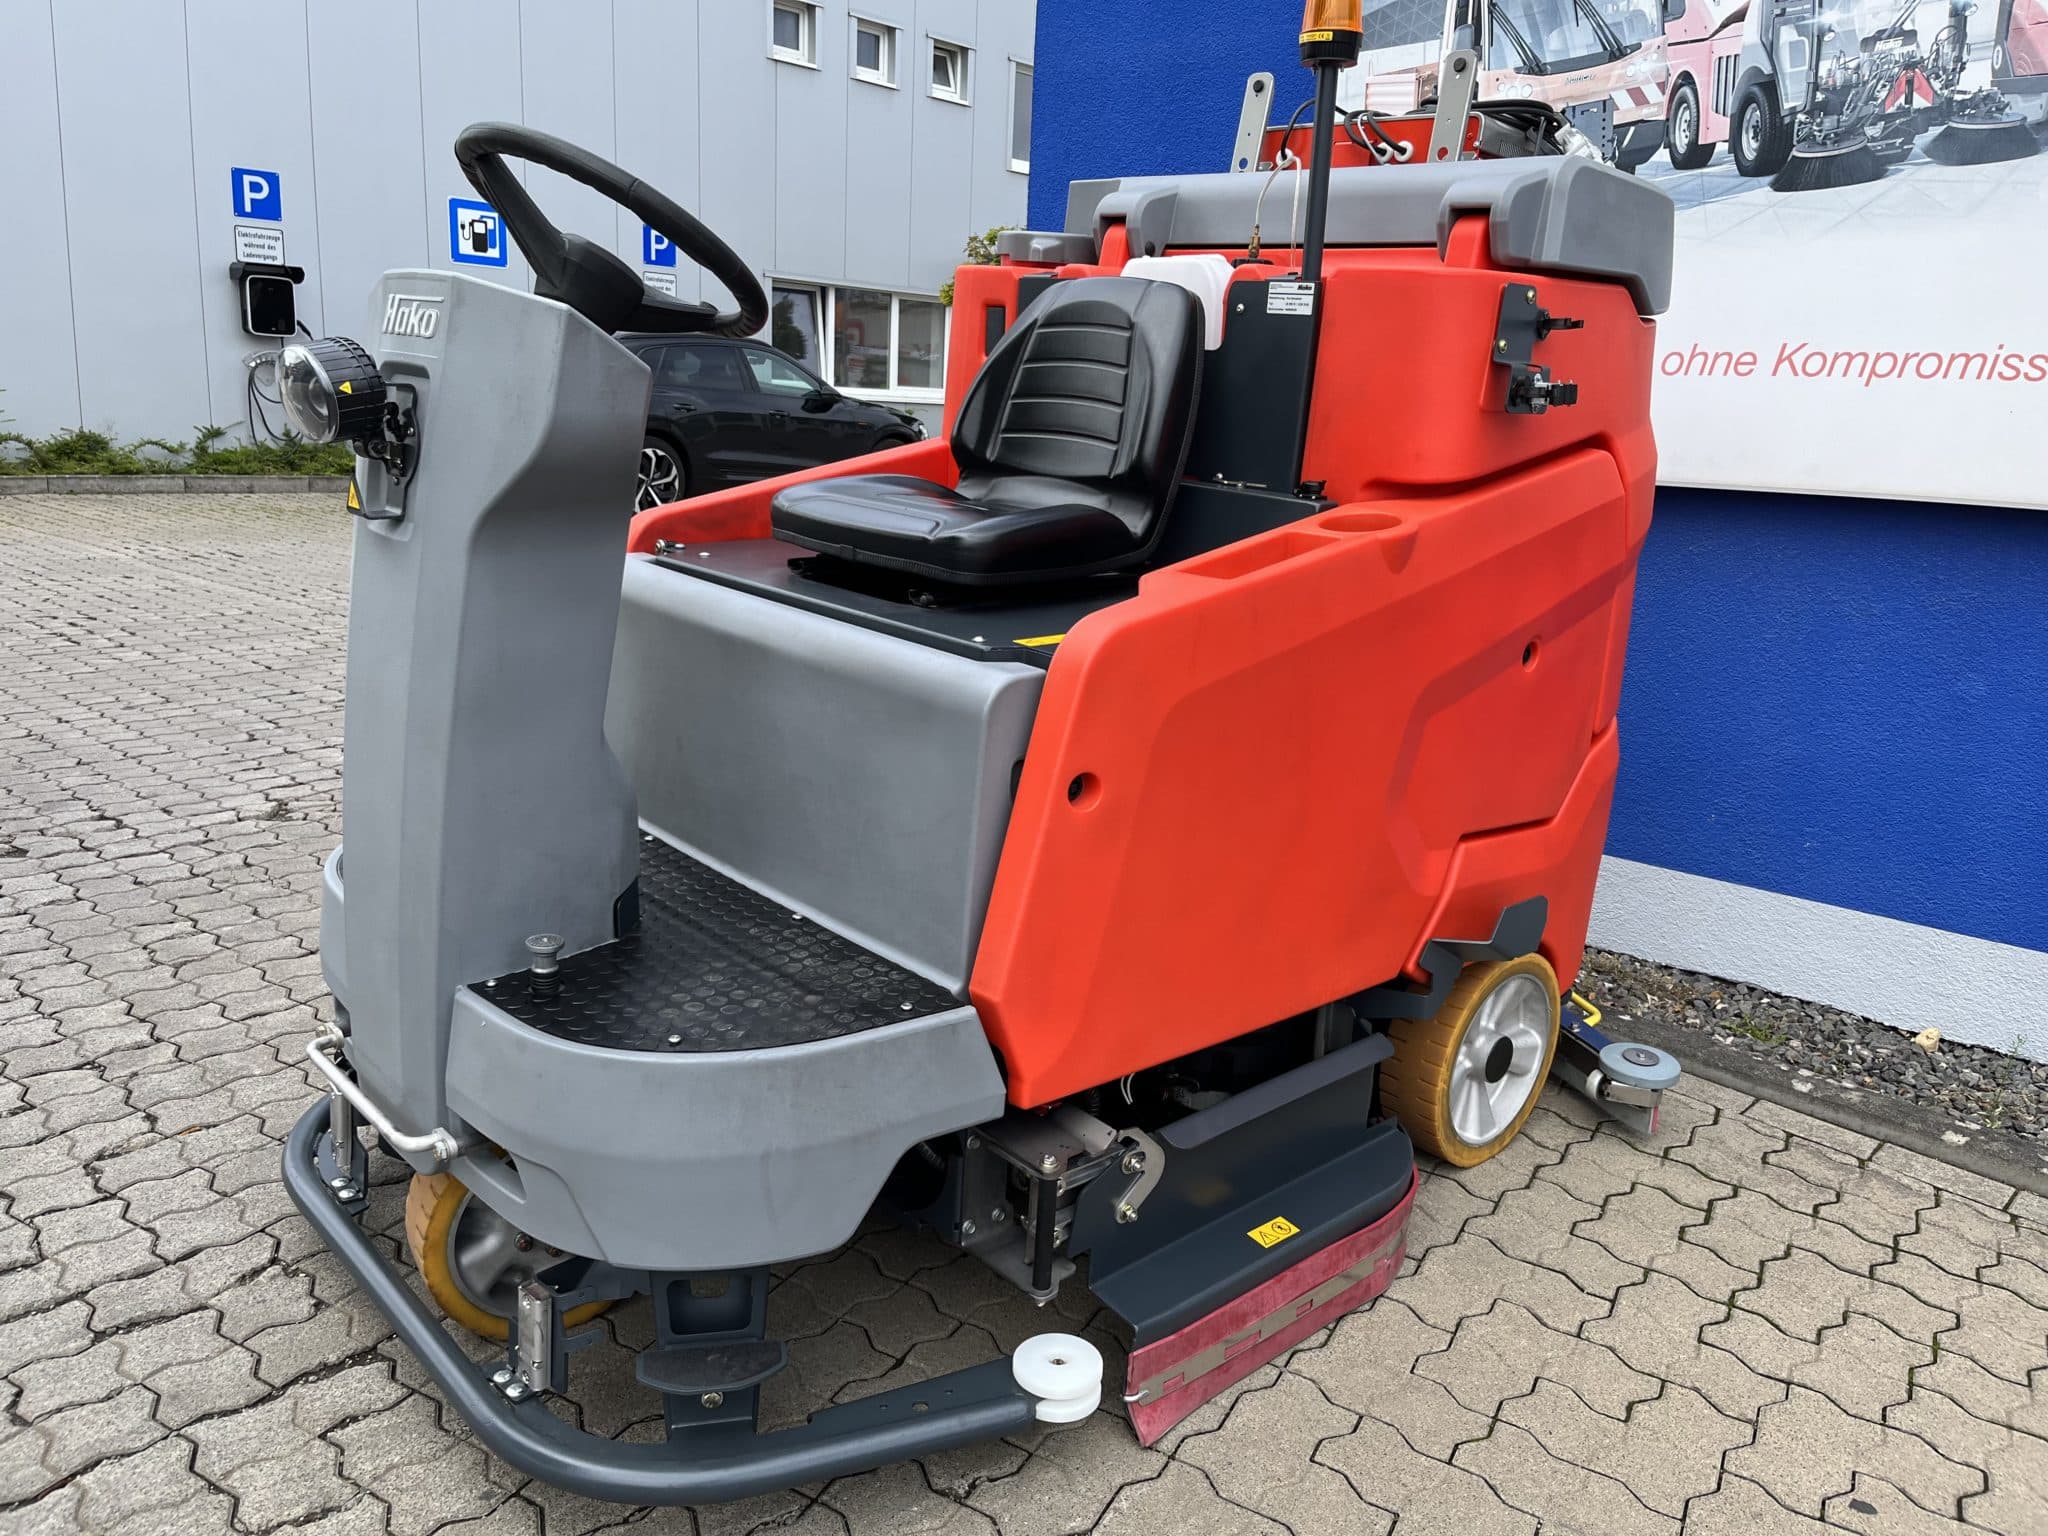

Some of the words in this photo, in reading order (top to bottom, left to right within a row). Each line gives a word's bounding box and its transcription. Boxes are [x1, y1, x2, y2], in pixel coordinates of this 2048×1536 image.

[243, 174, 269, 212] P
[267, 243, 276, 251] des
[650, 228, 669, 261] P
[382, 294, 444, 338] Hako
[1661, 343, 1757, 376] ohne
[1771, 342, 2048, 386] Kompromiss
